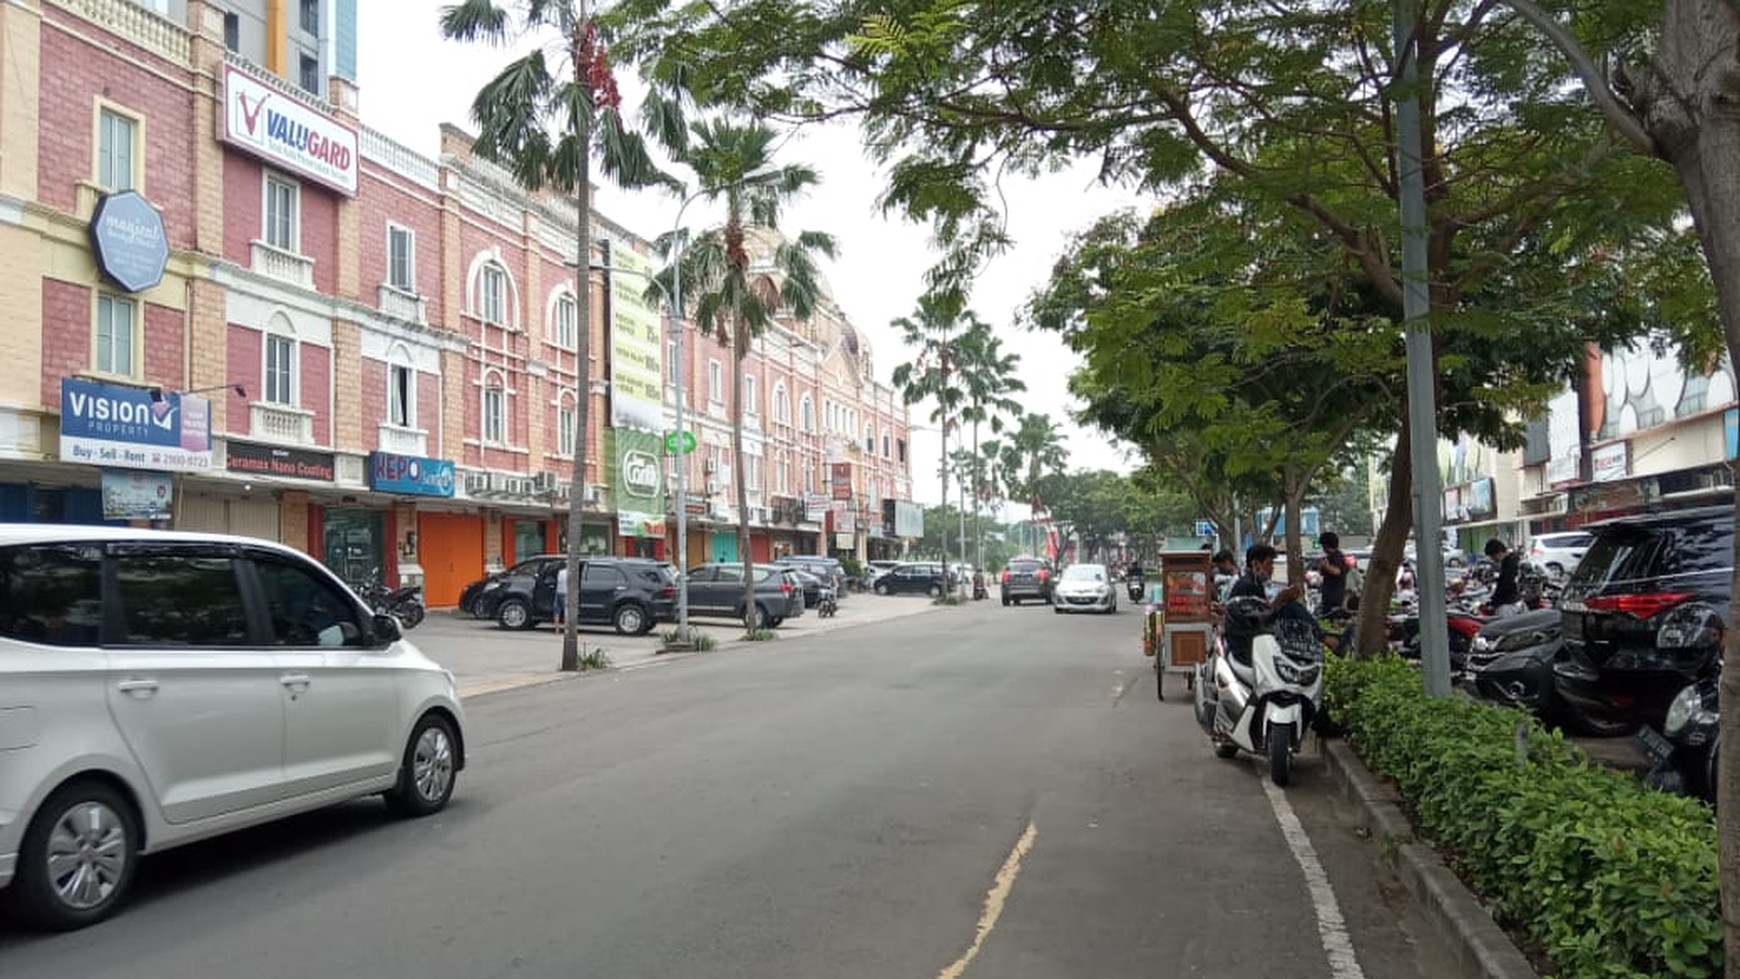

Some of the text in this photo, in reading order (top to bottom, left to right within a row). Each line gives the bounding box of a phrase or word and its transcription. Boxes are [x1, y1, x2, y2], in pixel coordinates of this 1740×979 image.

[267, 108, 350, 171] VALUGARD
[88, 421, 149, 437] PROPERTY
[73, 445, 146, 462] Buy Sell Rent
[271, 459, 296, 474] Nano
[297, 461, 332, 480] Coating
